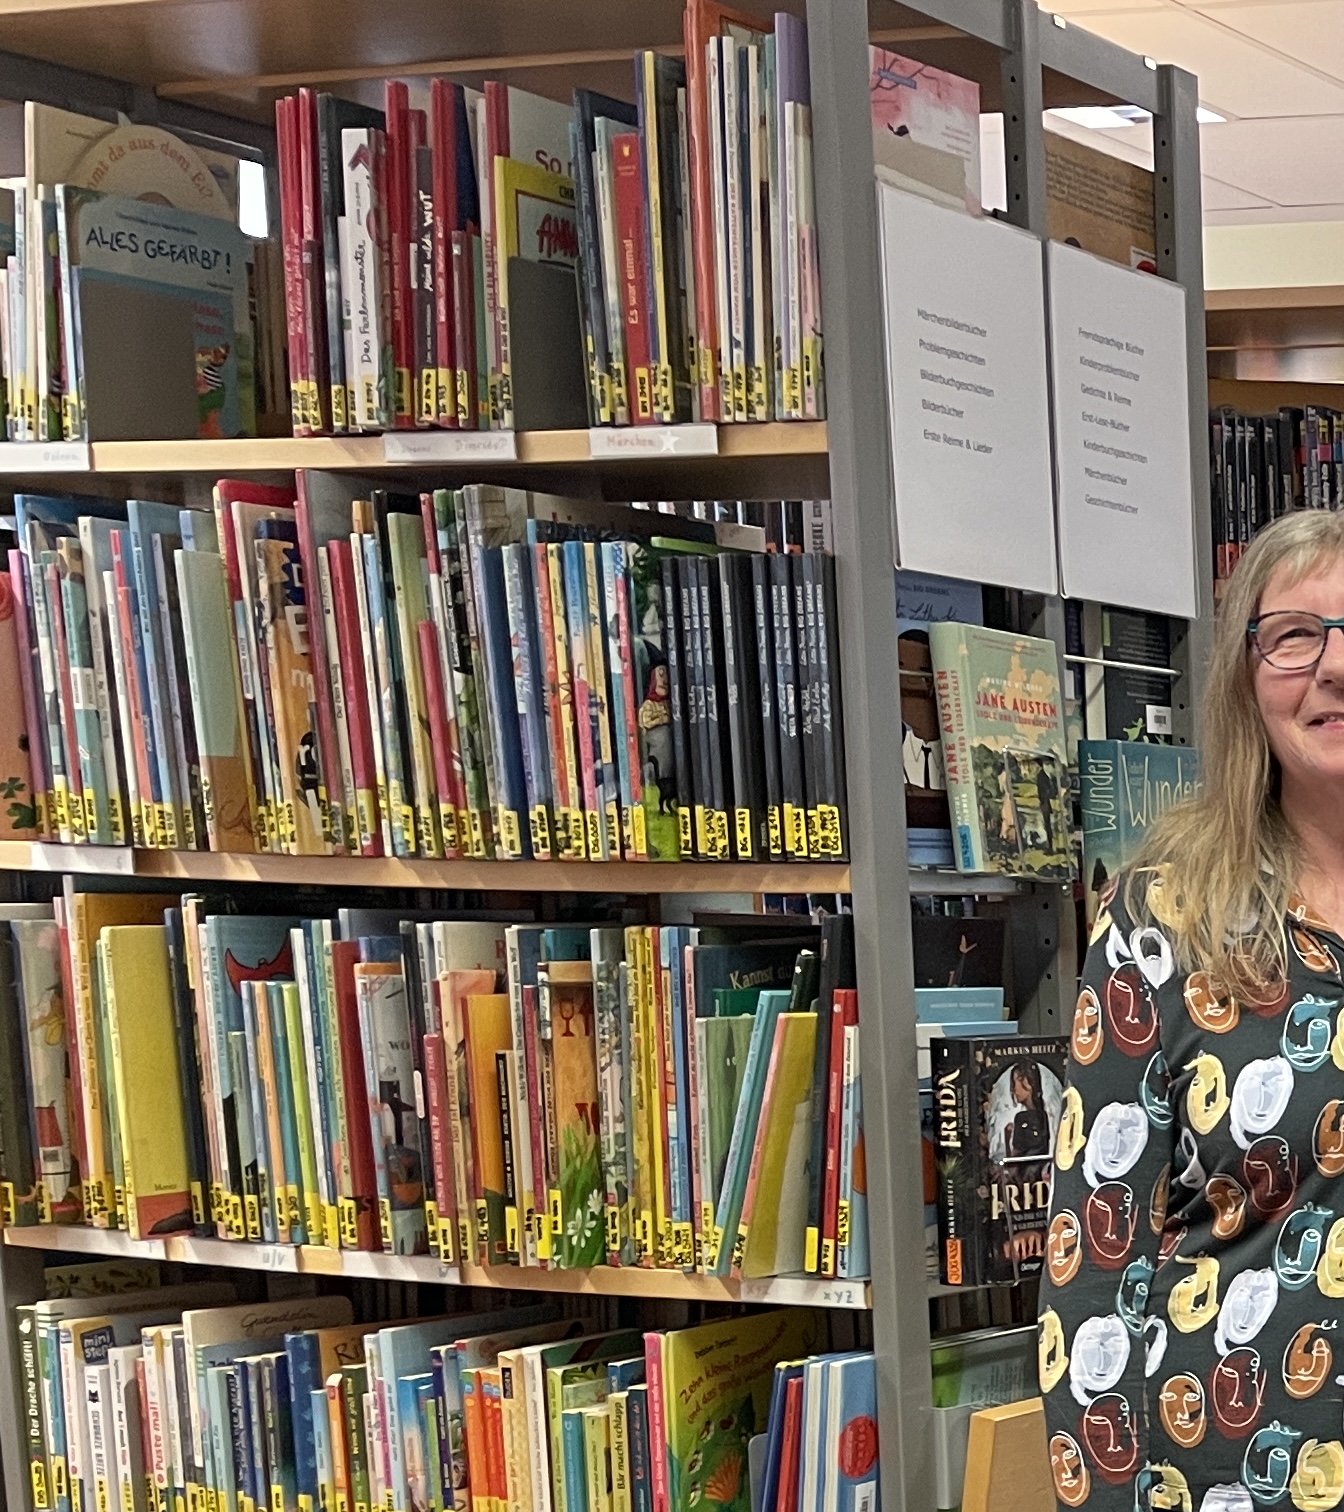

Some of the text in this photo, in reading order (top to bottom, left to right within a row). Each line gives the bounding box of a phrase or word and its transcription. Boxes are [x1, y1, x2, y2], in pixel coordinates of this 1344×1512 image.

[419, 190, 433, 227] WUT
[86, 227, 138, 254] ALLES
[975, 691, 1057, 718] JANE AUSTEN
[937, 670, 960, 785] JANE AUSTEN
[1085, 751, 1117, 834] Wunder
[730, 964, 774, 990] Kannst
